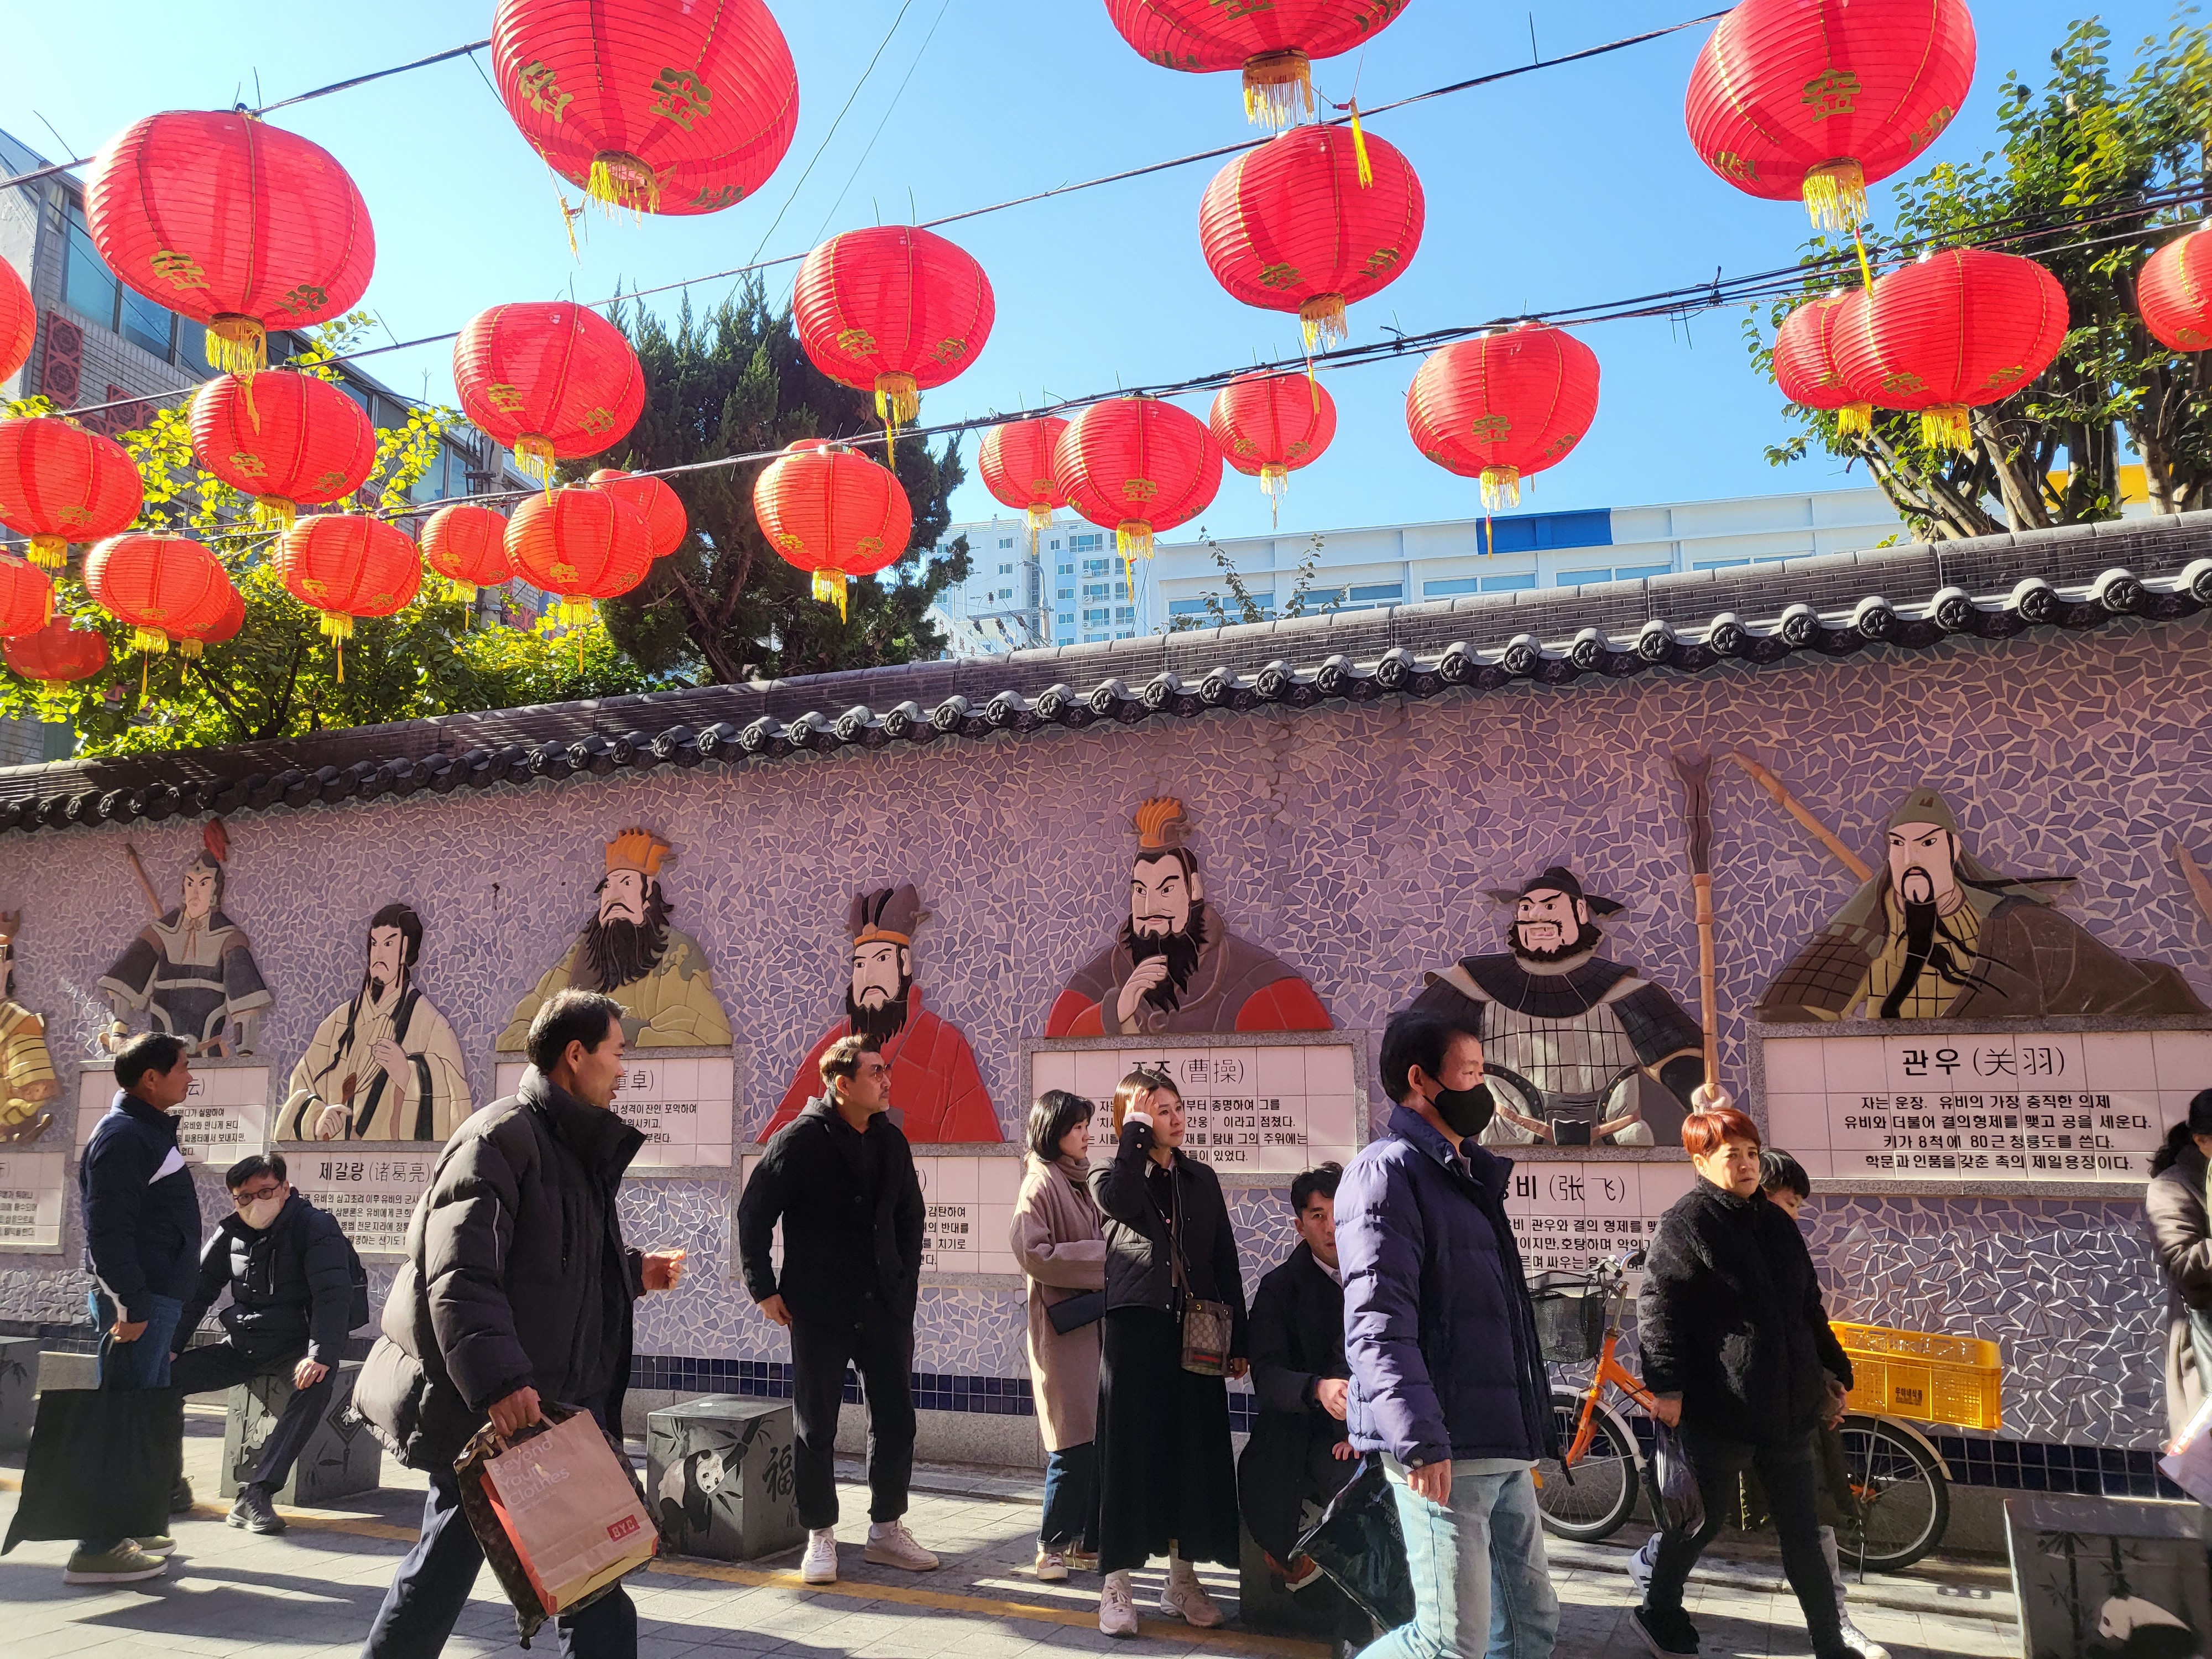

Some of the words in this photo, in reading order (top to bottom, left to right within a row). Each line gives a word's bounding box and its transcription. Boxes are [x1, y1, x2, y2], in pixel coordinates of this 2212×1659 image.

[1902, 1048, 1961, 1076] 관우
[1182, 1099, 1207, 1112] 부터
[1259, 1099, 1280, 1110] 그를
[1861, 1097, 1889, 1109] 자는
[1896, 1096, 1927, 1110] 운장.
[1939, 1095, 1984, 1109] 유비의
[1990, 1095, 2020, 1109] 가장
[2026, 1095, 2073, 1109] 충직한
[2079, 1094, 2111, 1109] 의제
[183, 1121, 202, 1130] 유비와
[1224, 1116, 1255, 1128] 이라고
[1260, 1115, 1296, 1128] 점쳤다.
[1845, 1116, 1886, 1129] 유비와
[1893, 1115, 1936, 1129] 더불어
[2025, 1115, 2056, 1129] 맺고
[2062, 1115, 2091, 1129] 공을
[2100, 1115, 2152, 1129] 세운다.
[1213, 1133, 1233, 1145] 탐내
[1238, 1133, 1258, 1145] 그의
[1264, 1133, 1307, 1145] 주위에는
[1883, 1135, 1912, 1149] 키가
[2078, 1135, 2114, 1149] 쓴다.
[1213, 1150, 1248, 1162] 있었다.
[1865, 1155, 1910, 1168] 학문과
[1913, 1155, 1956, 1168] 인품을
[1959, 1155, 1989, 1168] 갖춘
[1995, 1155, 2025, 1168] 촉의
[319, 1162, 364, 1181] 제갈량
[1503, 1175, 1537, 1200] 비
[314, 1194, 334, 1203] 유비의
[366, 1194, 380, 1204] 이후
[381, 1194, 402, 1204] 유비의
[366, 1208, 394, 1218] 유비에게
[928, 1206, 966, 1218] 감탄하여
[358, 1221, 371, 1231] 천문
[941, 1223, 969, 1234] 반대를
[1531, 1219, 1568, 1232] 관우와
[1573, 1219, 1598, 1232] 결의
[1604, 1220, 1642, 1233] 형제를
[378, 1235, 400, 1246] 신기도
[938, 1238, 966, 1250] 치기로
[1547, 1256, 1584, 1269] 싸우는
[491, 1434, 554, 1477] Beyond
[499, 1465, 538, 1490] Your
[508, 1467, 570, 1505] Clothes
[612, 1519, 635, 1538] BYC
